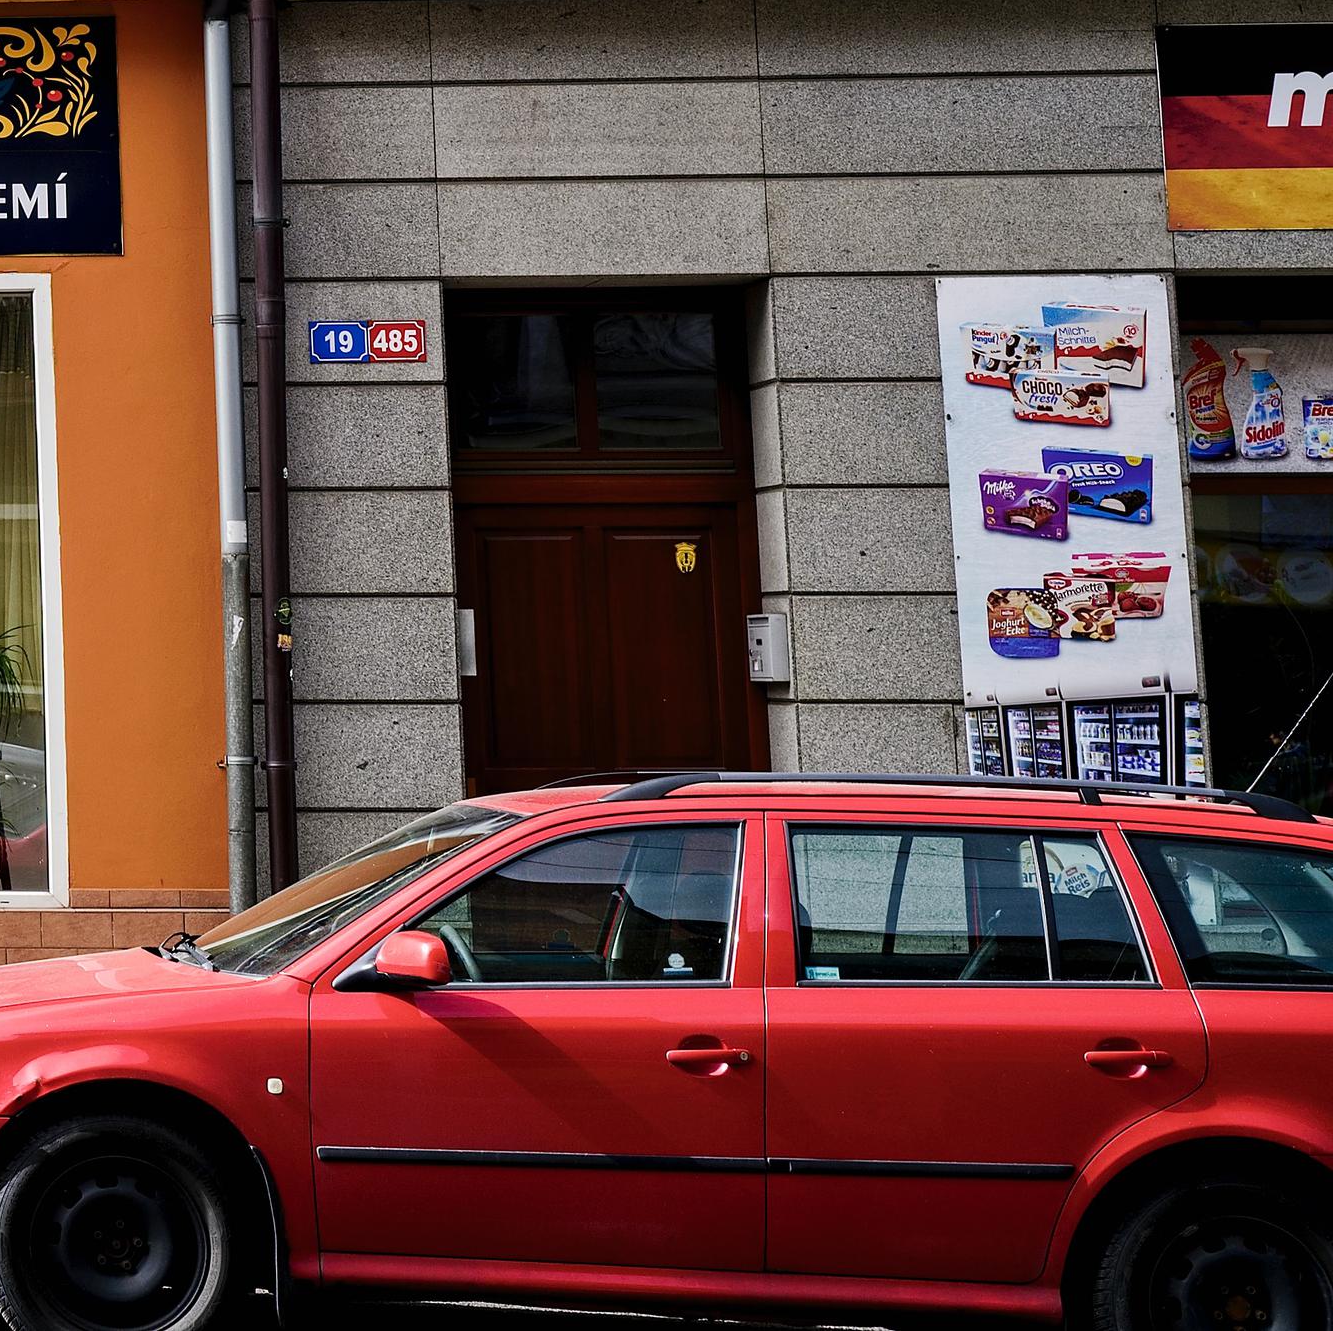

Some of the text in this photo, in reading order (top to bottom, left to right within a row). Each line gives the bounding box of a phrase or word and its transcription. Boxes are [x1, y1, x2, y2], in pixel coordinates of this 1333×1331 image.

[1058, 326, 1090, 337] Milch-
[324, 330, 353, 353] 19
[373, 329, 418, 352] 485
[1057, 335, 1097, 346] Schnitte
[1021, 380, 1063, 396] CHOCO
[1029, 392, 1059, 406] fresh
[1189, 390, 1217, 410] Bref
[1245, 421, 1285, 444] Sidolin
[1050, 462, 1121, 479] OREO
[983, 480, 1016, 496] Milka
[991, 617, 1025, 631] Joghurt
[1006, 626, 1026, 636] Ecke
[1064, 871, 1087, 887] Milch
